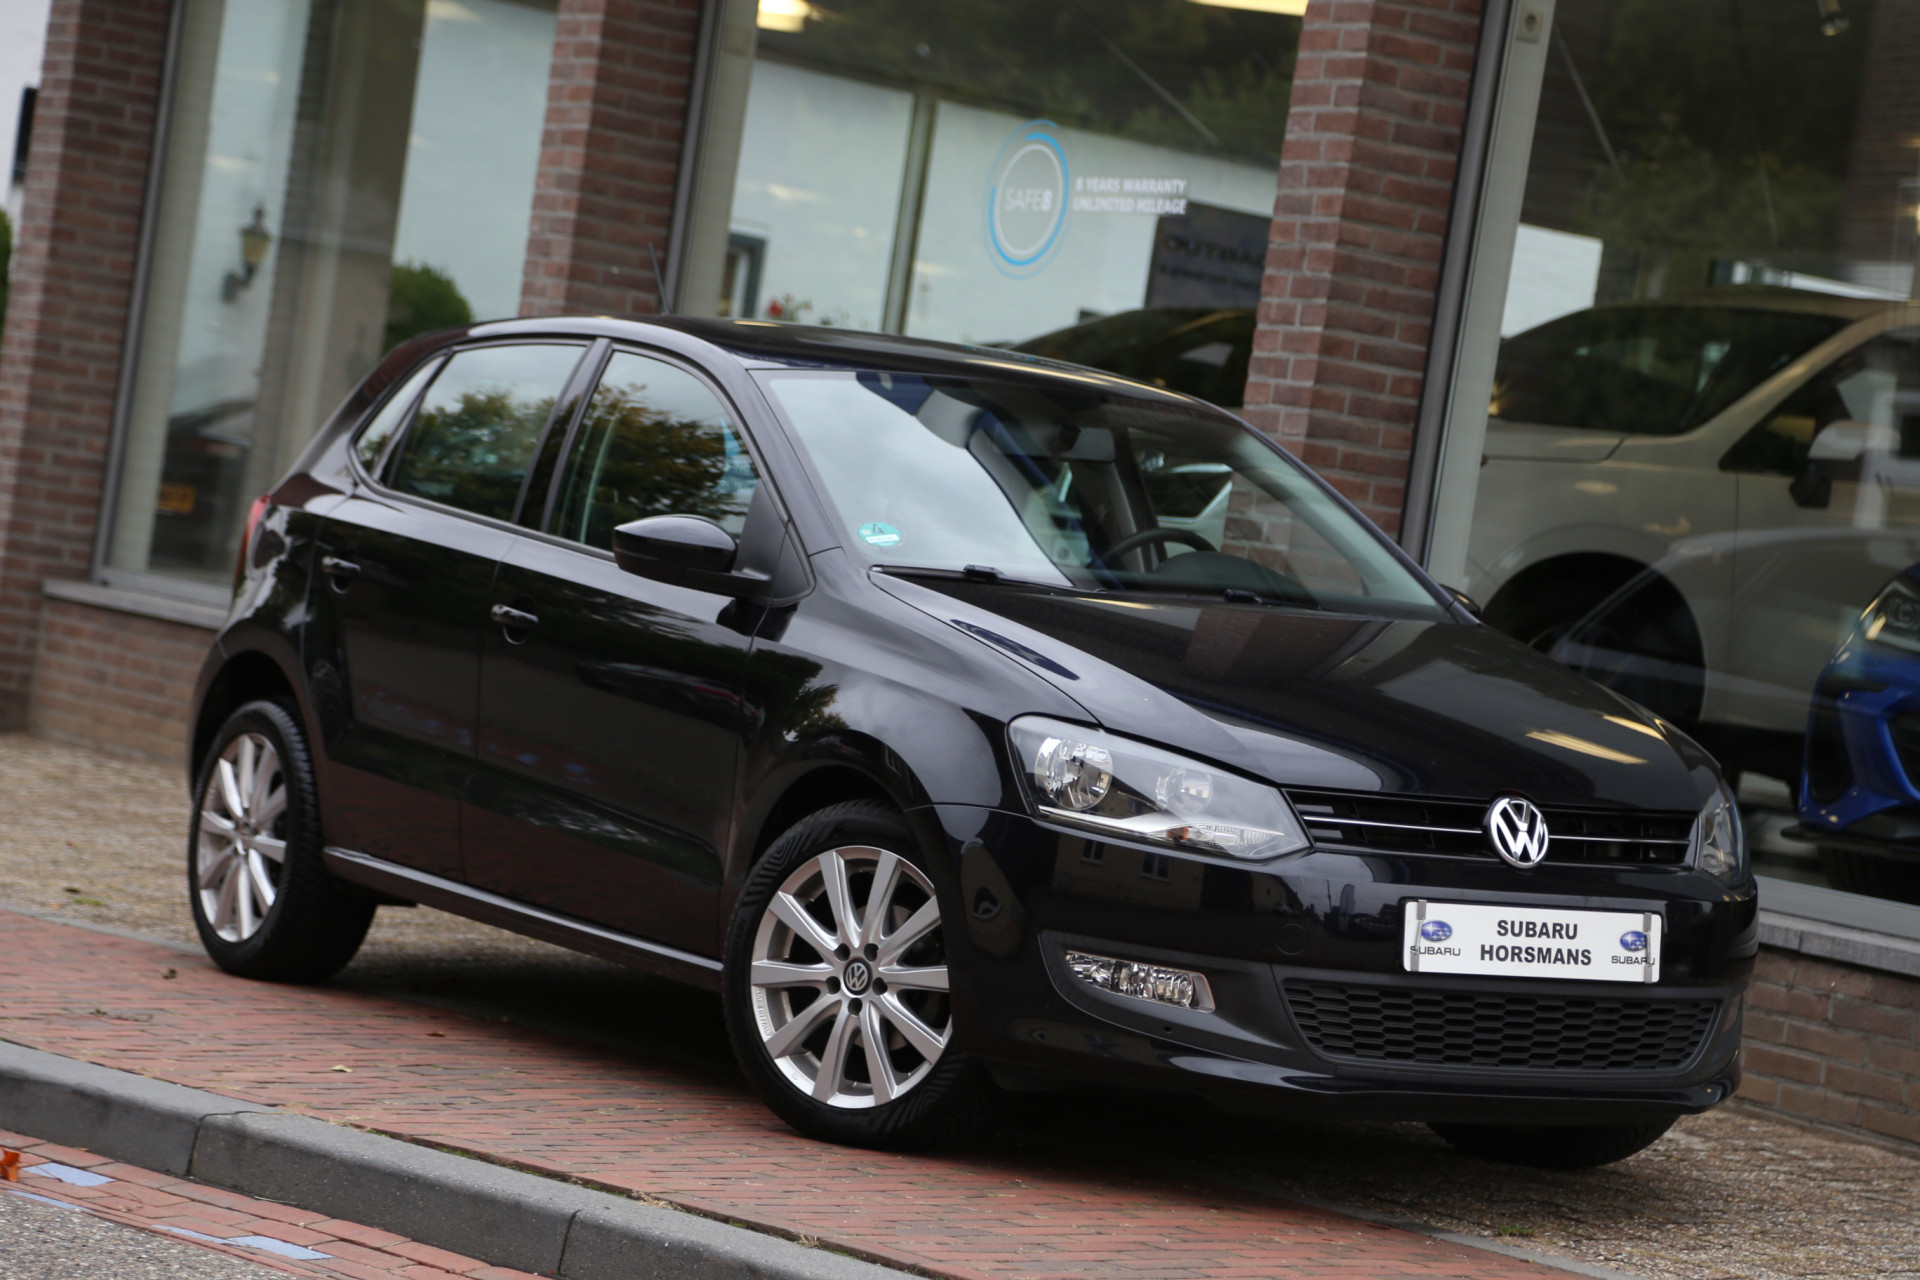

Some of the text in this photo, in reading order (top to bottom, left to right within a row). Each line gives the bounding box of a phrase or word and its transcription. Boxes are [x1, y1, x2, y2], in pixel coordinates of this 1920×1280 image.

[1085, 177, 1121, 192] YEARS
[1122, 179, 1187, 194] WARRANTY
[1004, 188, 1054, 211] SAFE8
[1072, 197, 1187, 214] UNLIMITED MILEAGE
[1496, 919, 1578, 940] SUBARU
[1409, 945, 1461, 957] SUBARU
[1480, 944, 1592, 966] HORSMANS
